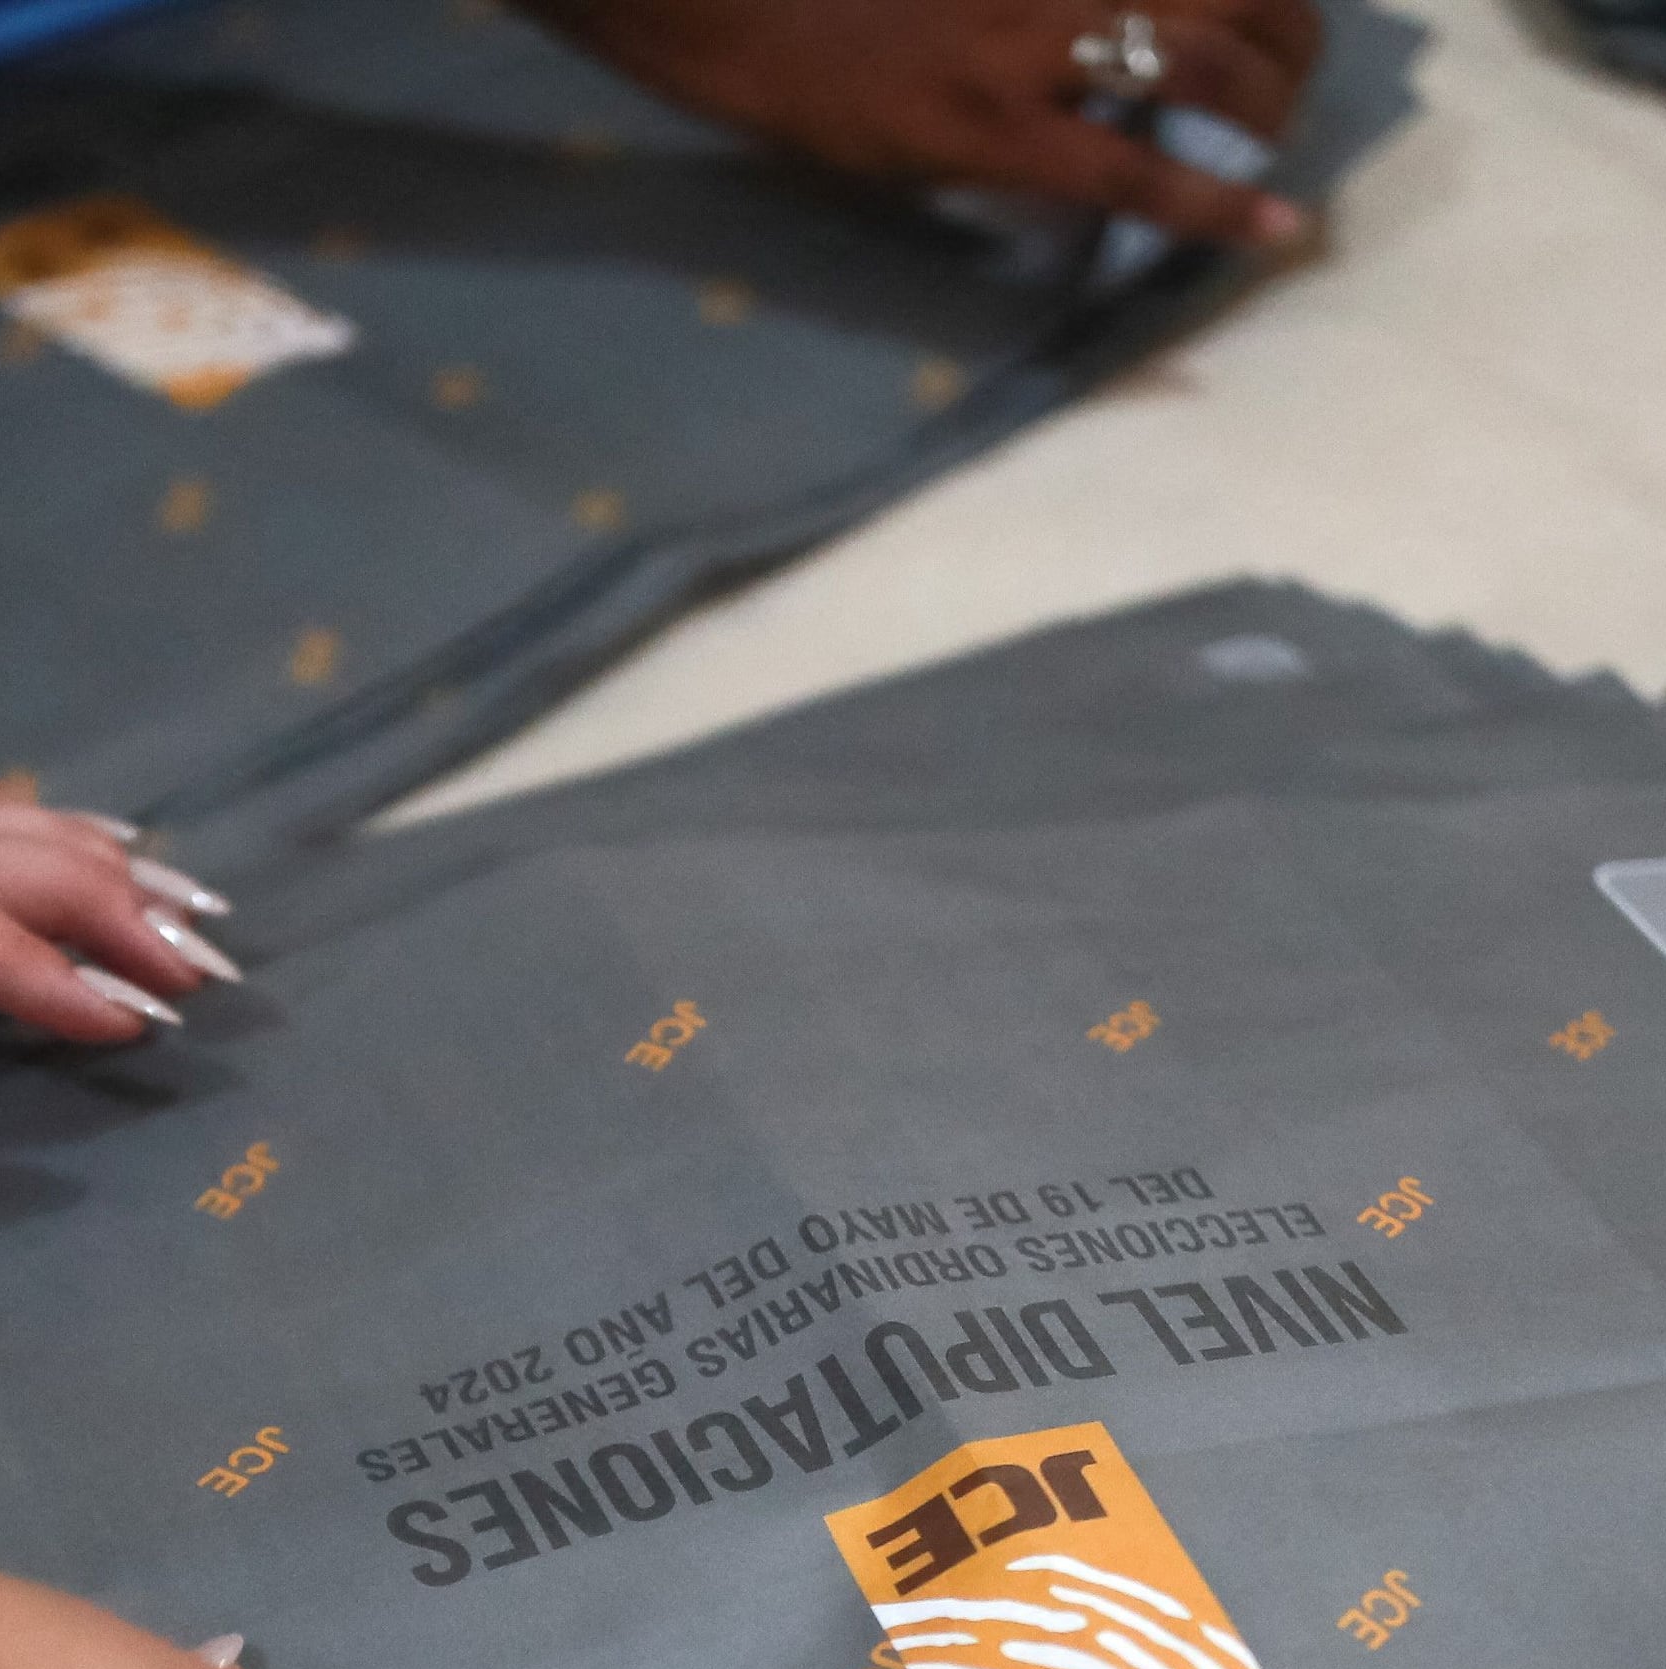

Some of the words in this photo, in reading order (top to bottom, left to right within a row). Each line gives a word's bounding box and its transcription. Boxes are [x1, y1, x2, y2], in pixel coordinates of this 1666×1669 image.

[623, 999, 708, 1071] JCE
[195, 1141, 281, 1220] JCE
[955, 1189, 1032, 1231] DE
[1036, 1180, 1101, 1218] 19
[1109, 1167, 1217, 1207] DEL
[1355, 1176, 1435, 1240] JCE
[797, 1200, 950, 1254] MAYO
[1018, 1201, 1327, 1274] ELECCIONES
[682, 1236, 792, 1310] DEL
[563, 1291, 675, 1367] AÑO
[685, 1243, 1008, 1379] ORDINARIAS
[1096, 1259, 1411, 1366] NIVEL
[418, 1344, 555, 1415] 2024
[354, 1358, 677, 1484] GENERALES
[385, 1298, 1118, 1588] DIPUTACIONES
[196, 1425, 290, 1498] JCE
[865, 1448, 1110, 1598] JCE
[1335, 1568, 1423, 1651] JCE
